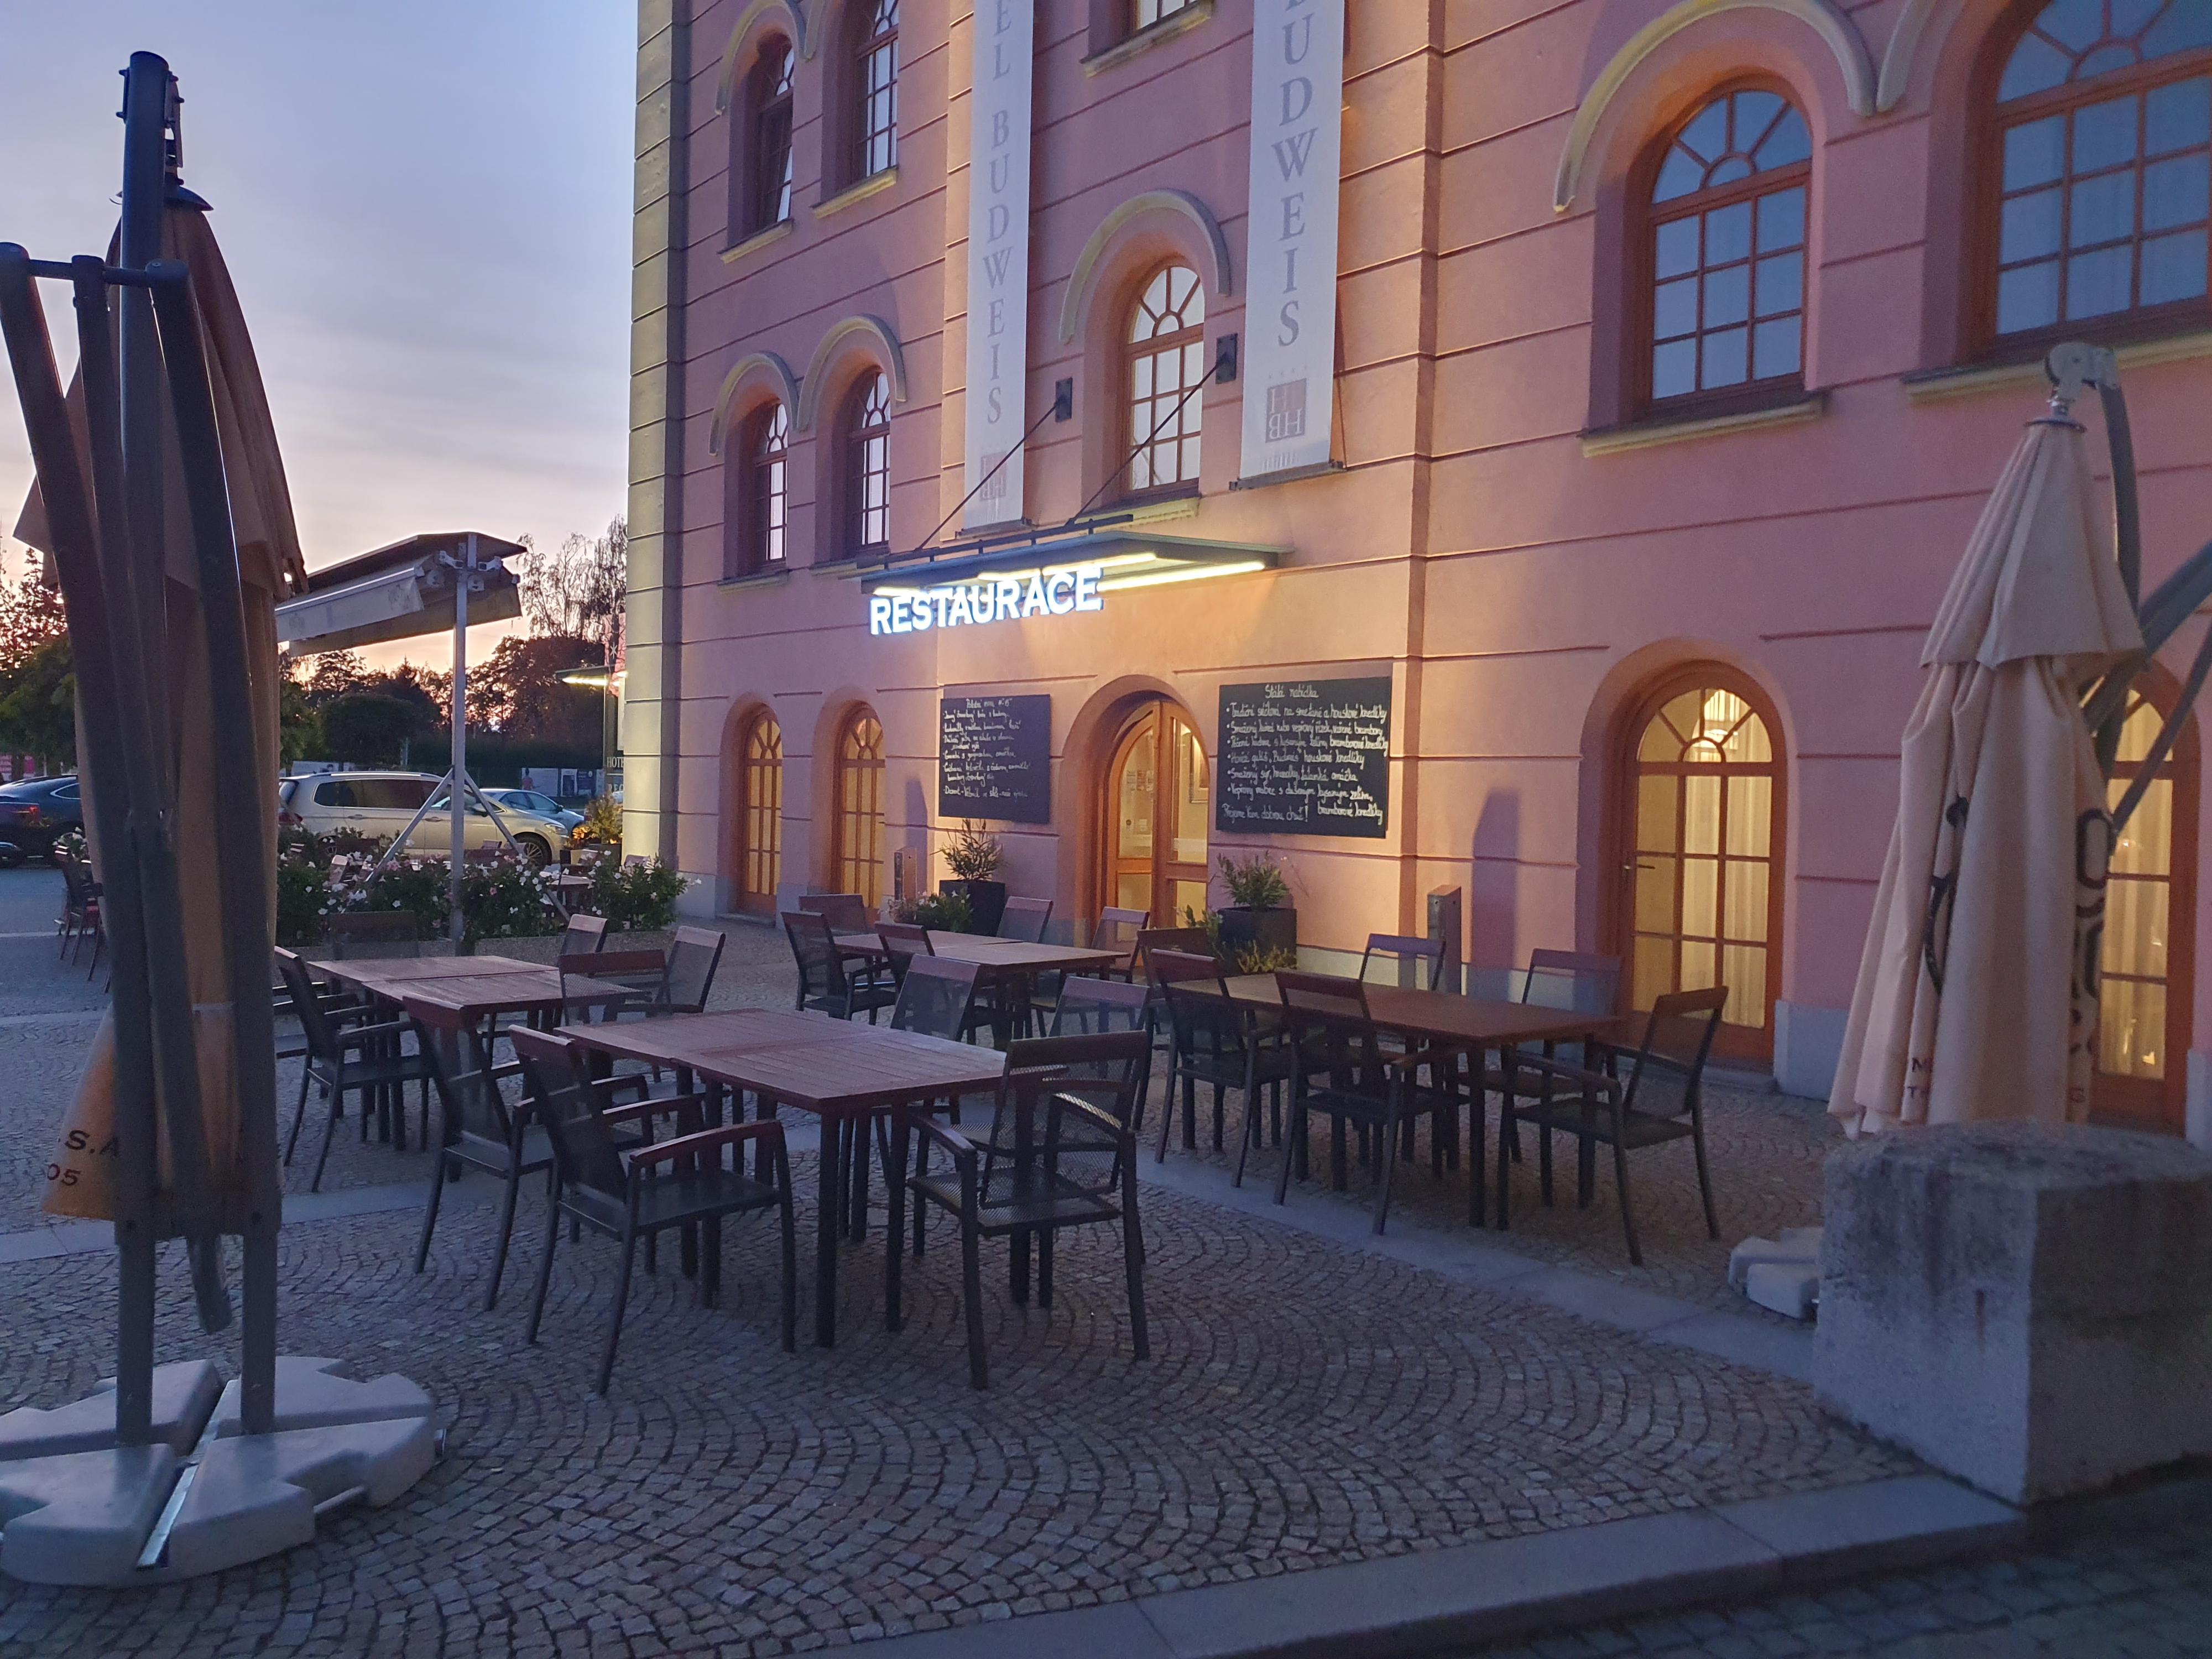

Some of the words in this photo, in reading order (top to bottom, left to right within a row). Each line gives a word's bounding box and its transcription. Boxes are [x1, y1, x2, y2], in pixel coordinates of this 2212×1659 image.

[983, 109, 1011, 426] BUDWEIS
[1272, 0, 1319, 347] UDWEIS
[870, 566, 1103, 635] RESTAURACE
